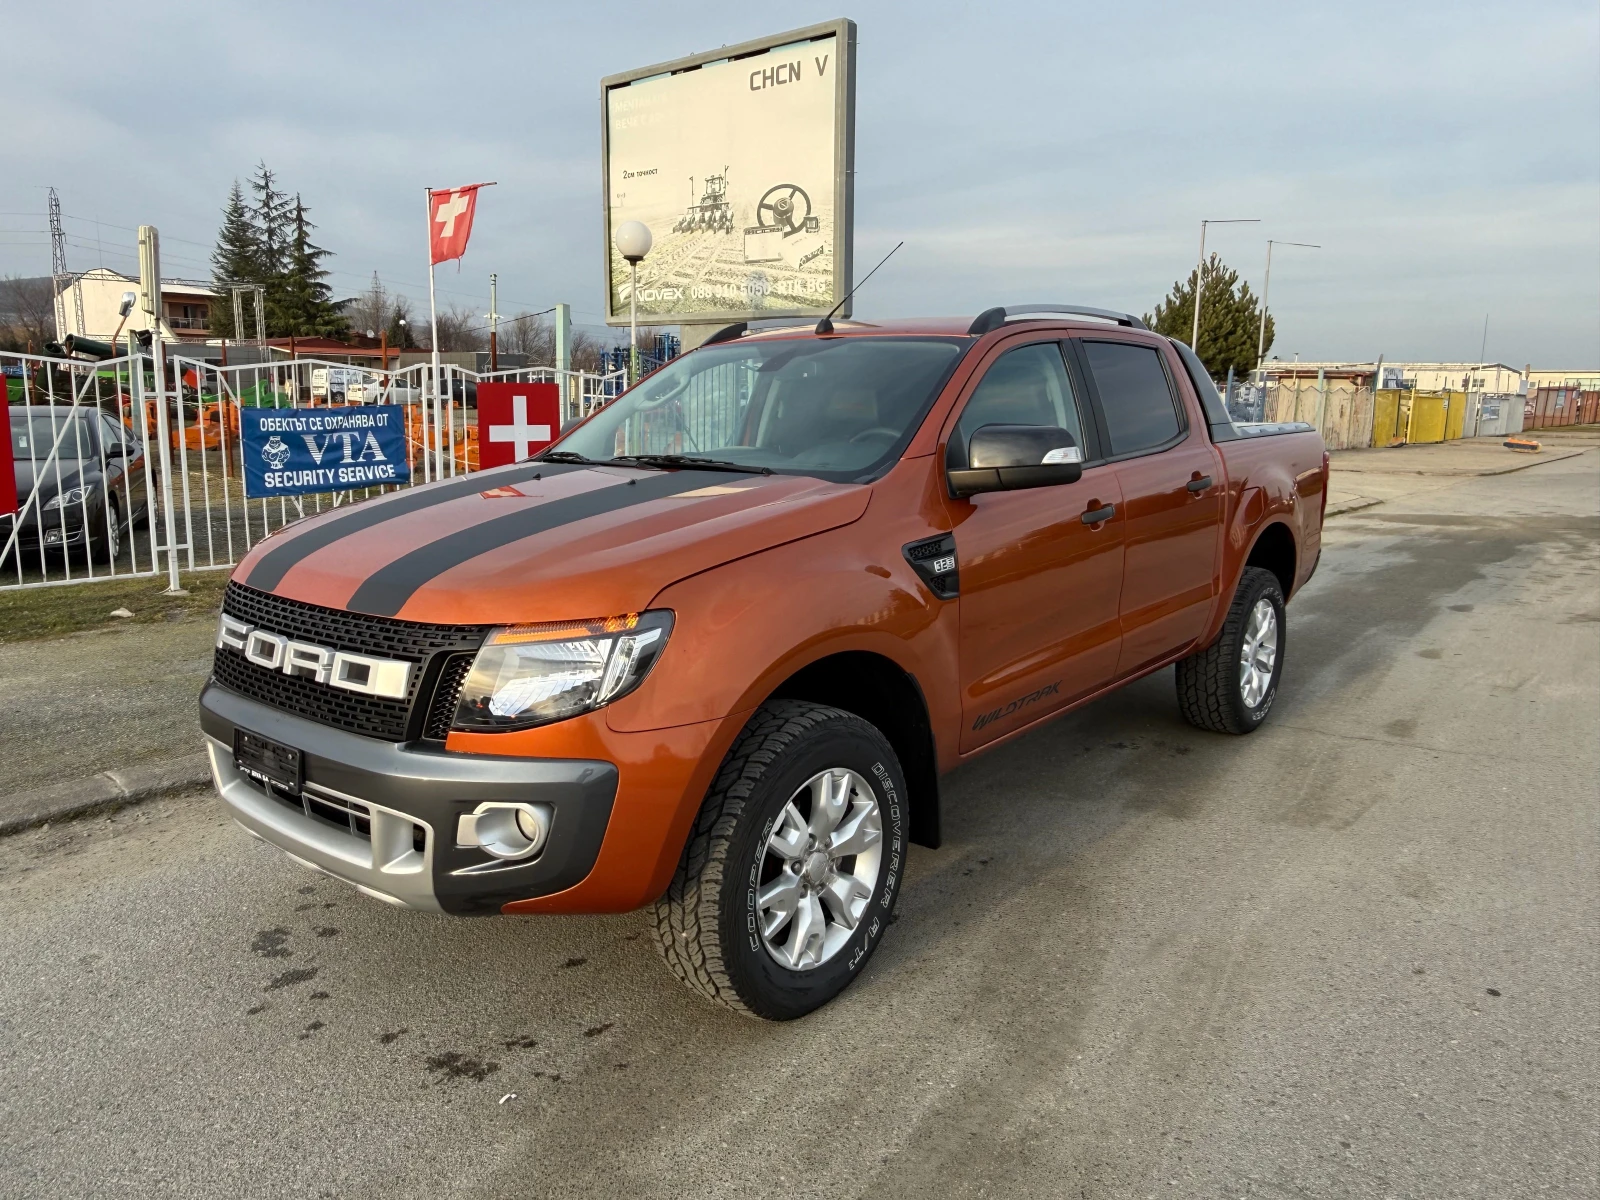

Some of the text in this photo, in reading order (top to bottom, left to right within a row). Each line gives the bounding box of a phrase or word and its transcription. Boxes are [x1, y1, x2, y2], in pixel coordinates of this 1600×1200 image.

[259, 413, 389, 432] ОБЕКТЪТ СЕ ОХРАНЯВА ОТ
[301, 430, 388, 466] VTA
[264, 463, 396, 488] SECURITY SERVICE
[216, 613, 412, 700] FORD
[972, 679, 1064, 731] WILDTRAK
[871, 761, 902, 909] DISCOVERER
[747, 816, 773, 953] COOPER
